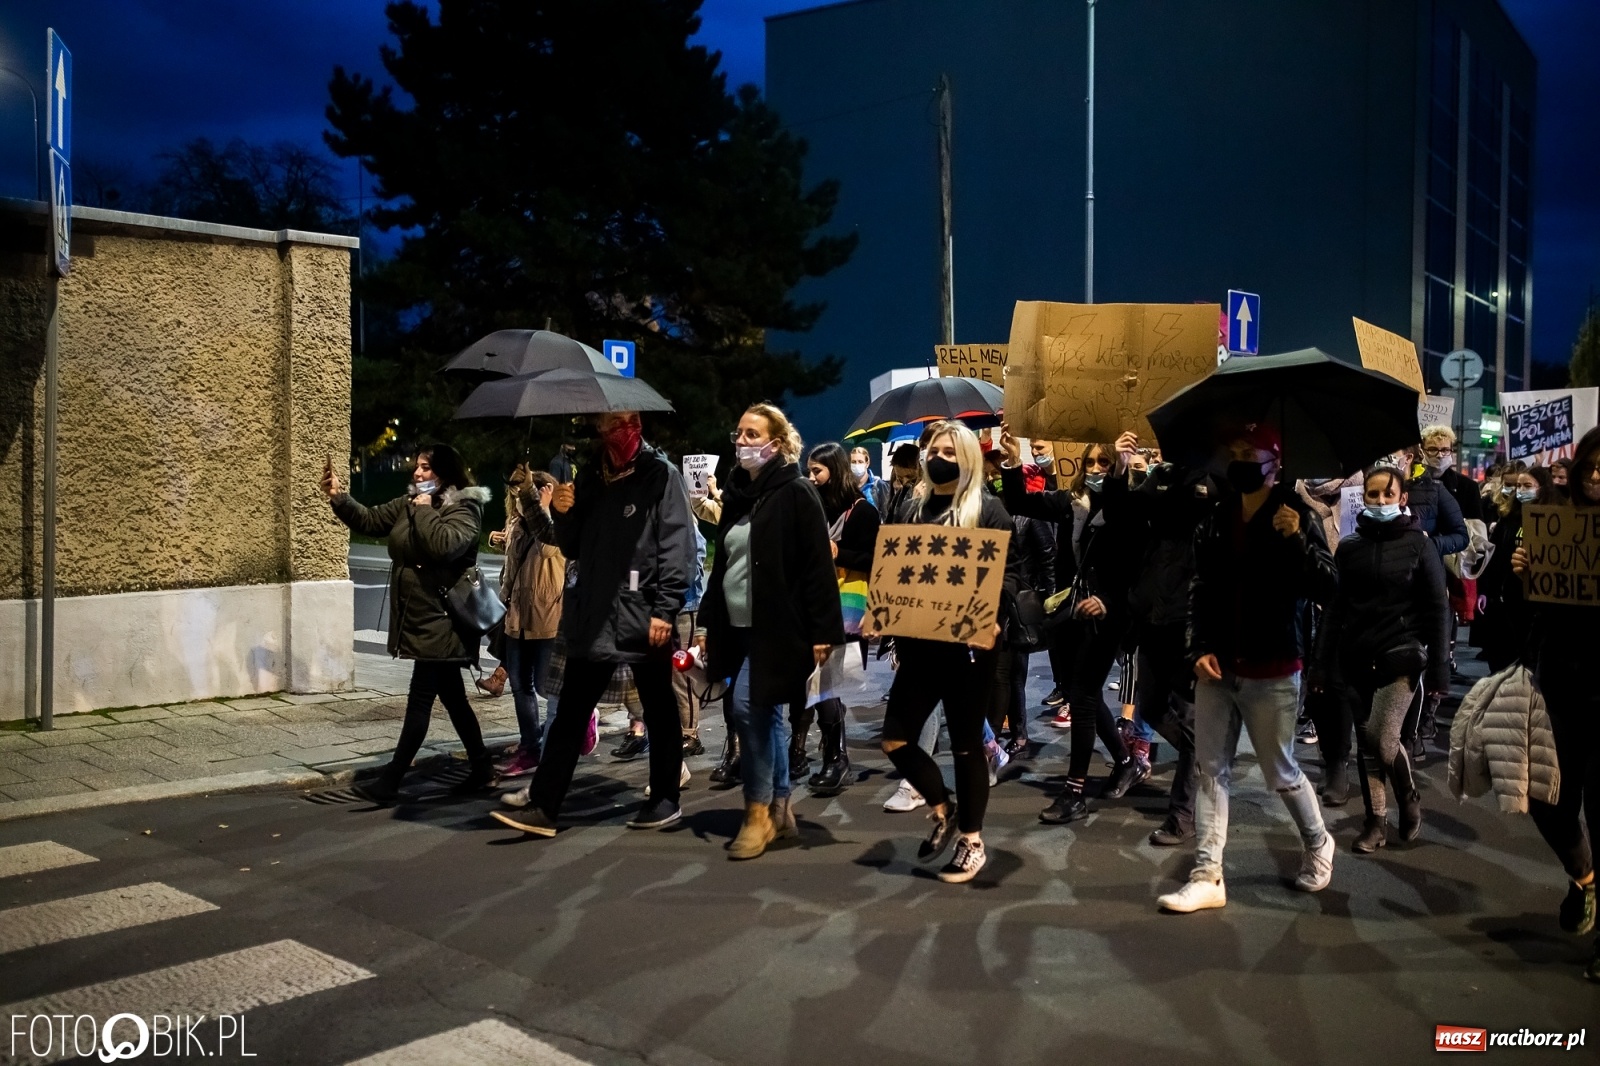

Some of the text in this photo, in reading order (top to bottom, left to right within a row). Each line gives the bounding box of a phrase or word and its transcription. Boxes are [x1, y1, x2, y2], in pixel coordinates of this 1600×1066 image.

[940, 347, 1008, 366] REAL MEN
[1530, 513, 1561, 537] TO
